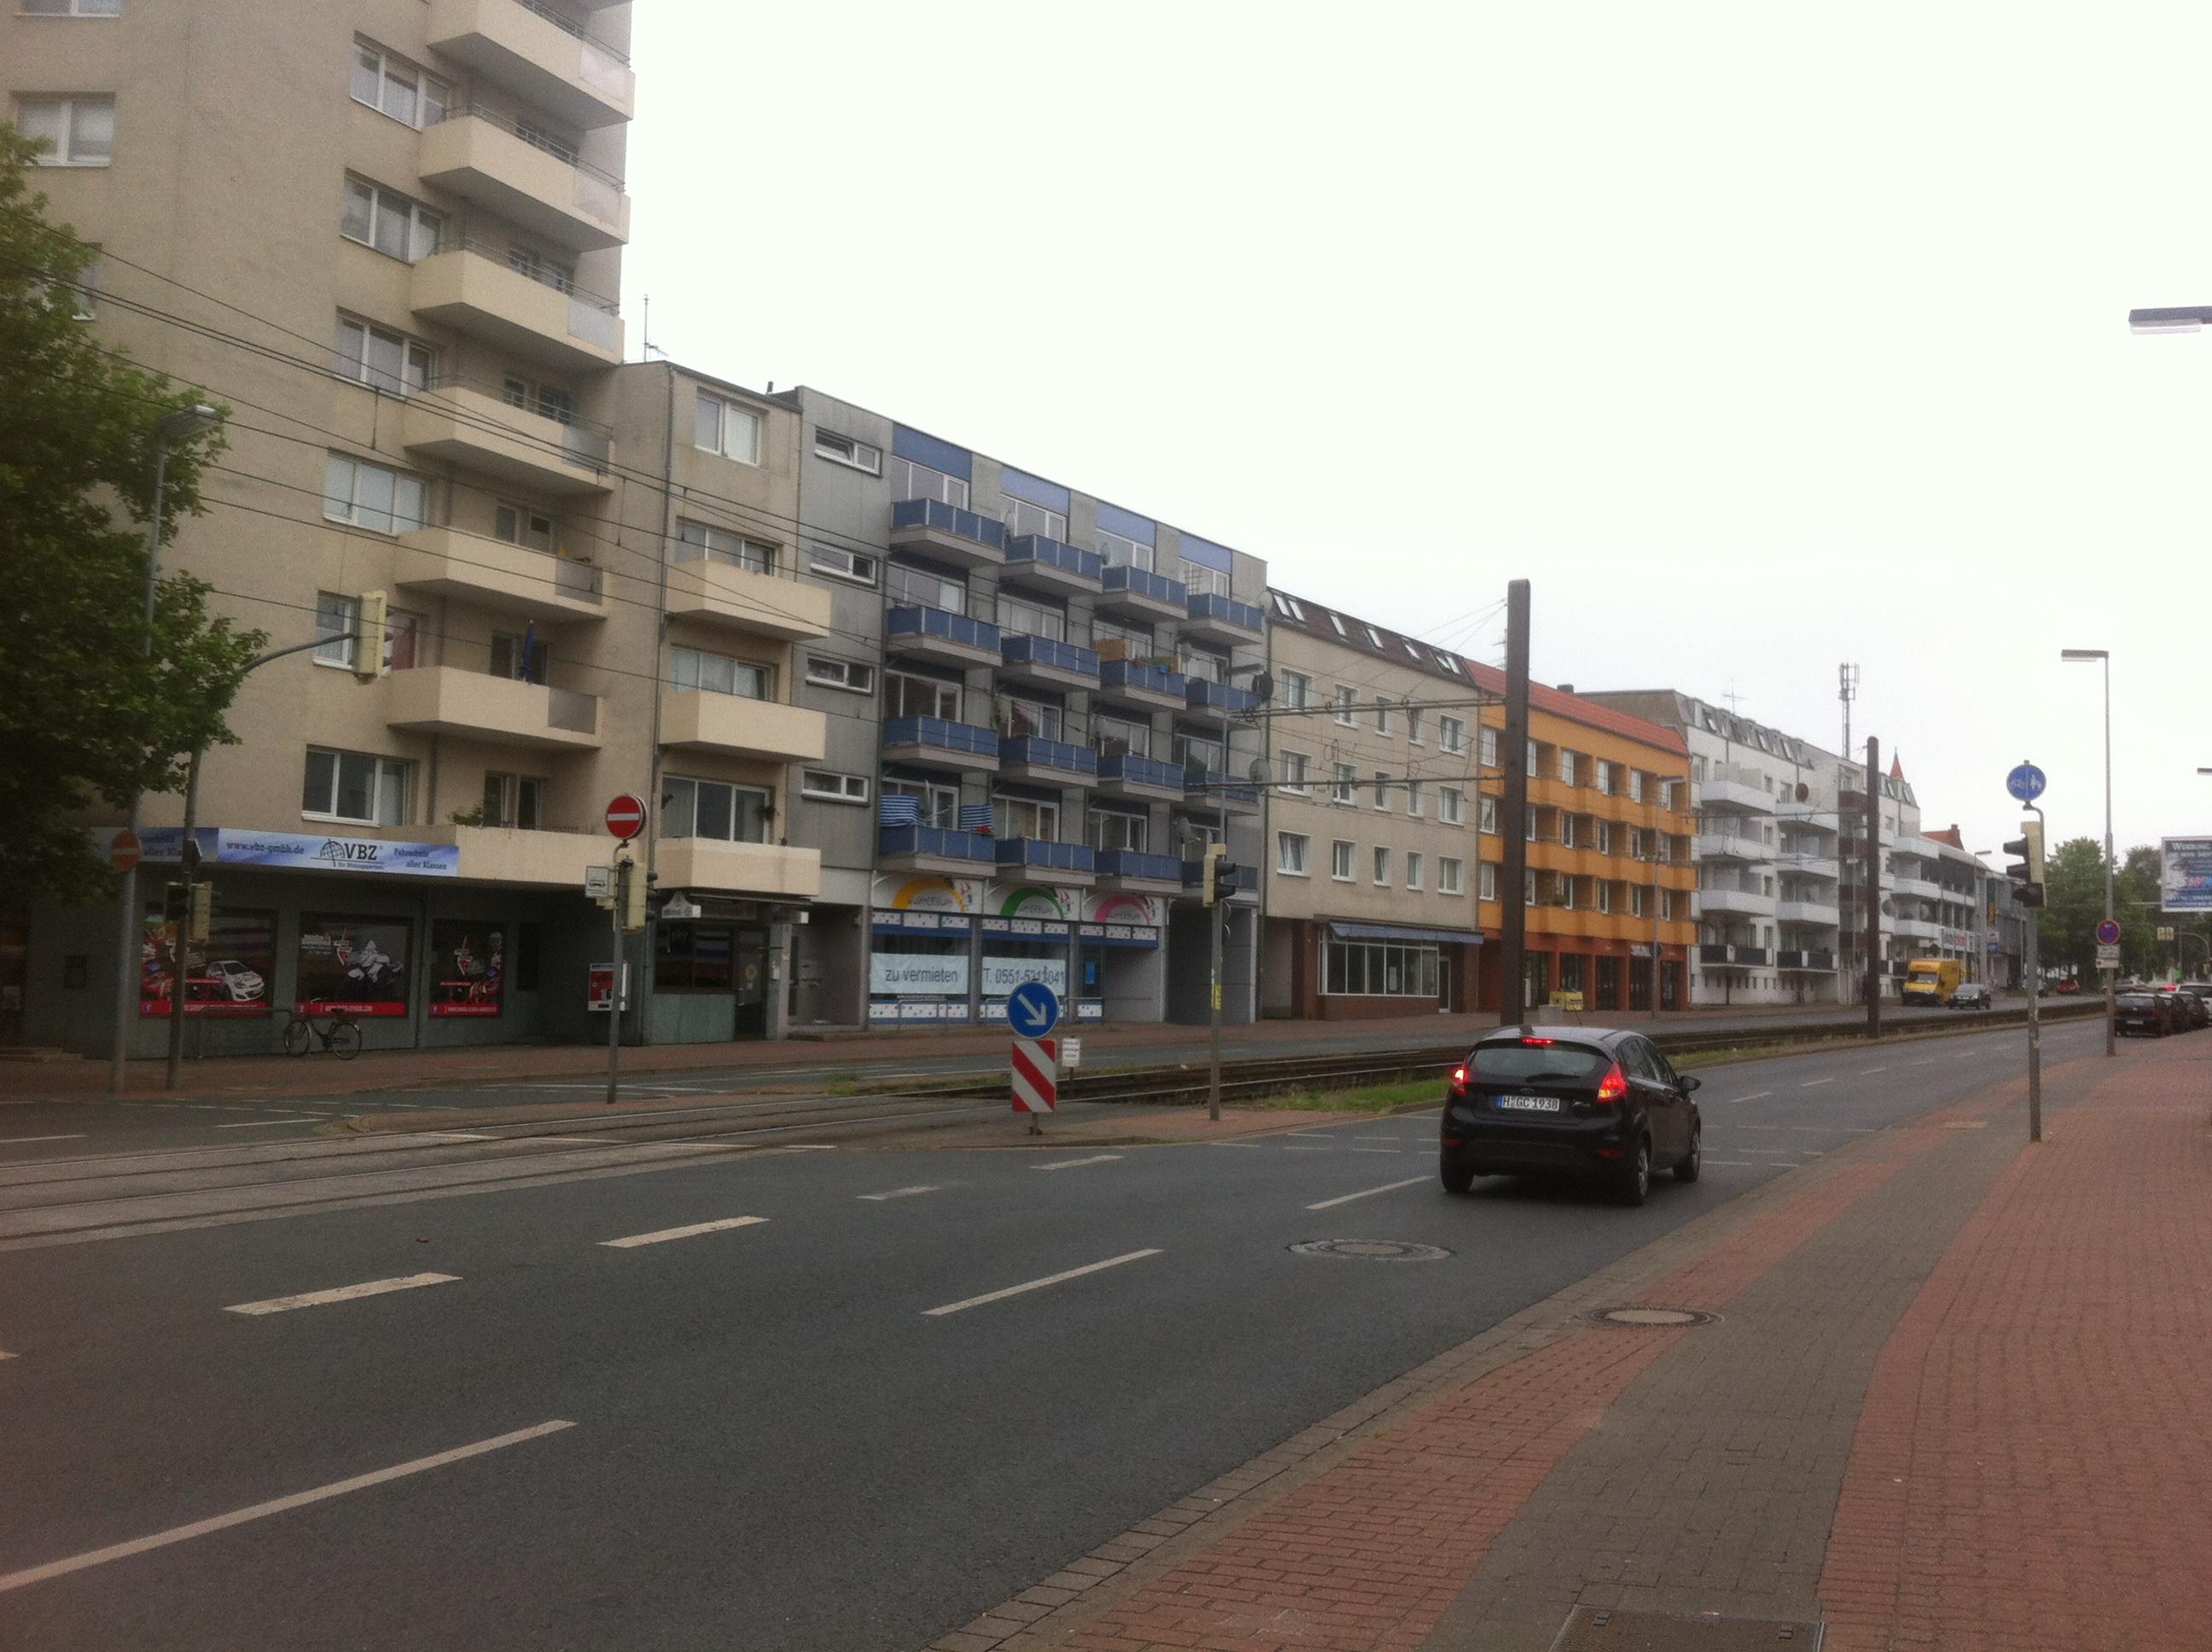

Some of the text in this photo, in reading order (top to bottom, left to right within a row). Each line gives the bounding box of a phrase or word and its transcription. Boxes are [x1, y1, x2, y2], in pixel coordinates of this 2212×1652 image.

[344, 843, 377, 860] VBZ
[885, 966, 958, 982] zu vermieten
